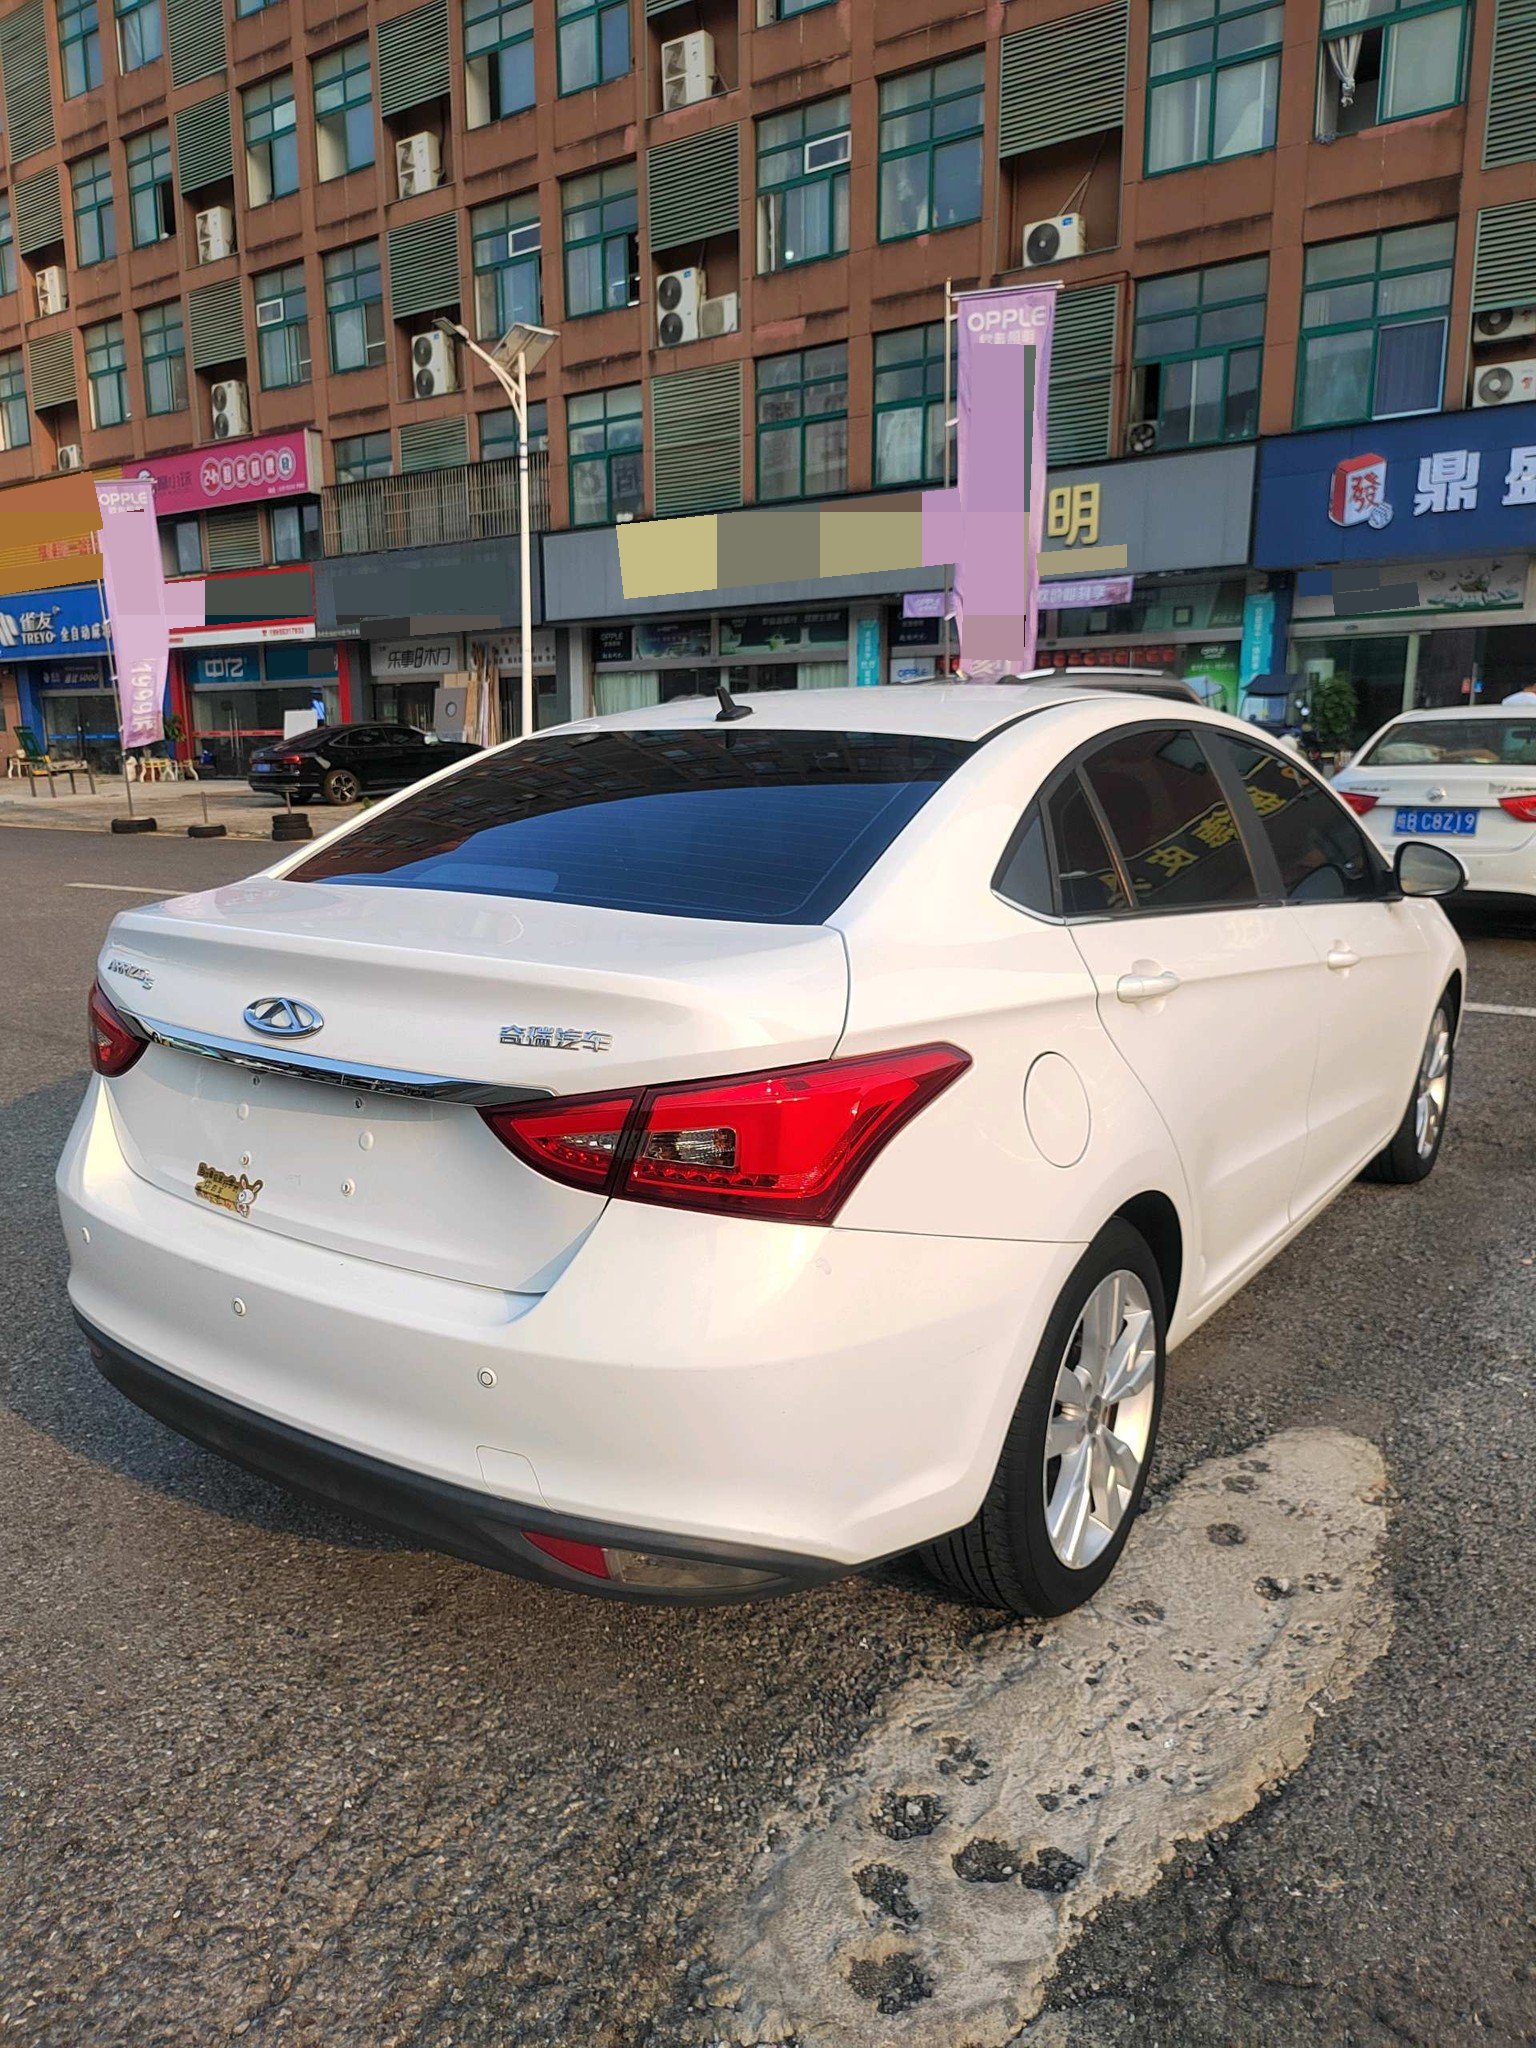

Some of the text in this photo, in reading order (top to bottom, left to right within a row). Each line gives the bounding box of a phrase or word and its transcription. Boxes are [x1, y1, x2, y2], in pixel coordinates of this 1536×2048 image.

[967, 305, 1047, 332] OPPLE
[99, 492, 149, 506] OPPLE
[1047, 482, 1101, 546] 明
[20, 630, 56, 645] TREYO
[499, 1024, 614, 1053] 奇瑞汽车
